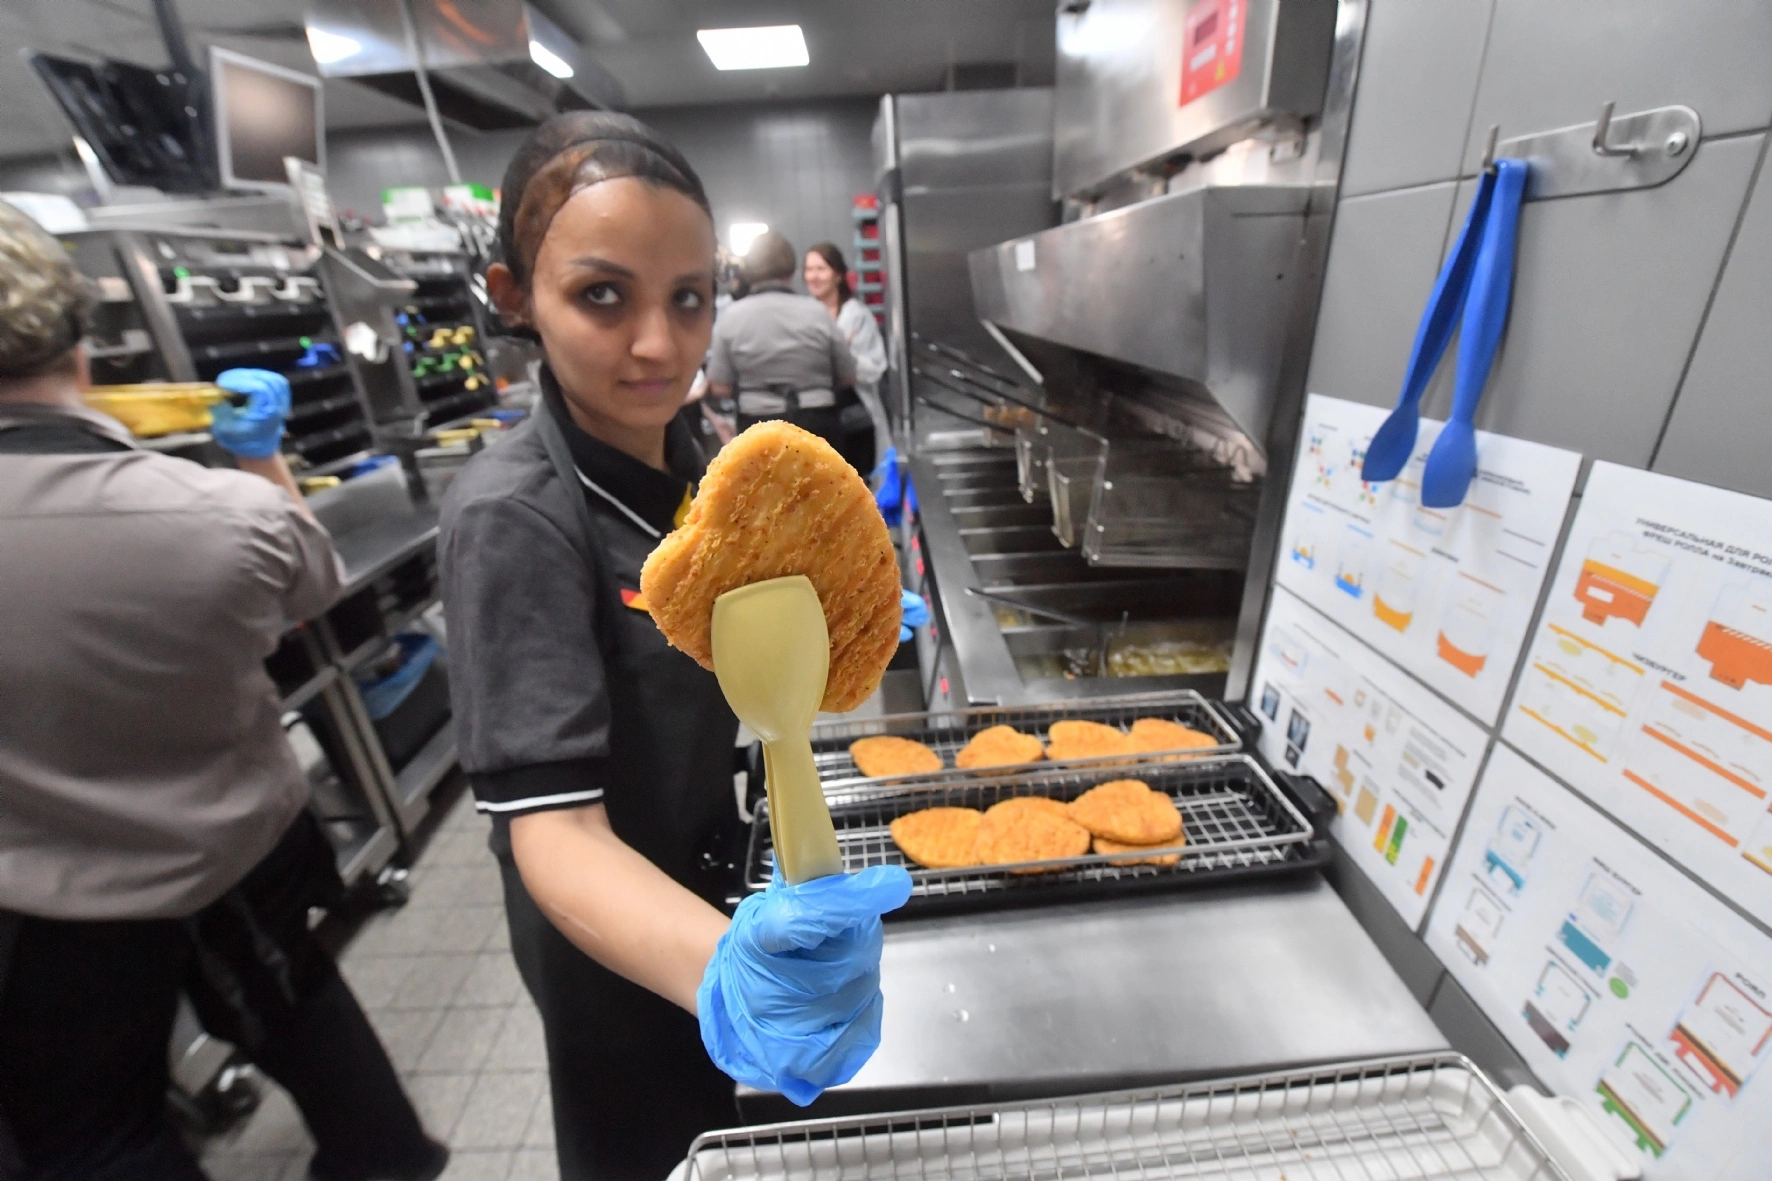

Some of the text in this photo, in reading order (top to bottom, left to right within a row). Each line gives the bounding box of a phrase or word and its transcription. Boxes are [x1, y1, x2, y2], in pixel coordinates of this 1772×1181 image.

[1636, 517, 1724, 549] УНИВЕРСАЛЬНАЯ
[1724, 545, 1750, 558] ДЛЯ
[1674, 540, 1709, 556] РОЛЛА
[1632, 652, 1686, 681] ЧИЗБУРГЕР
